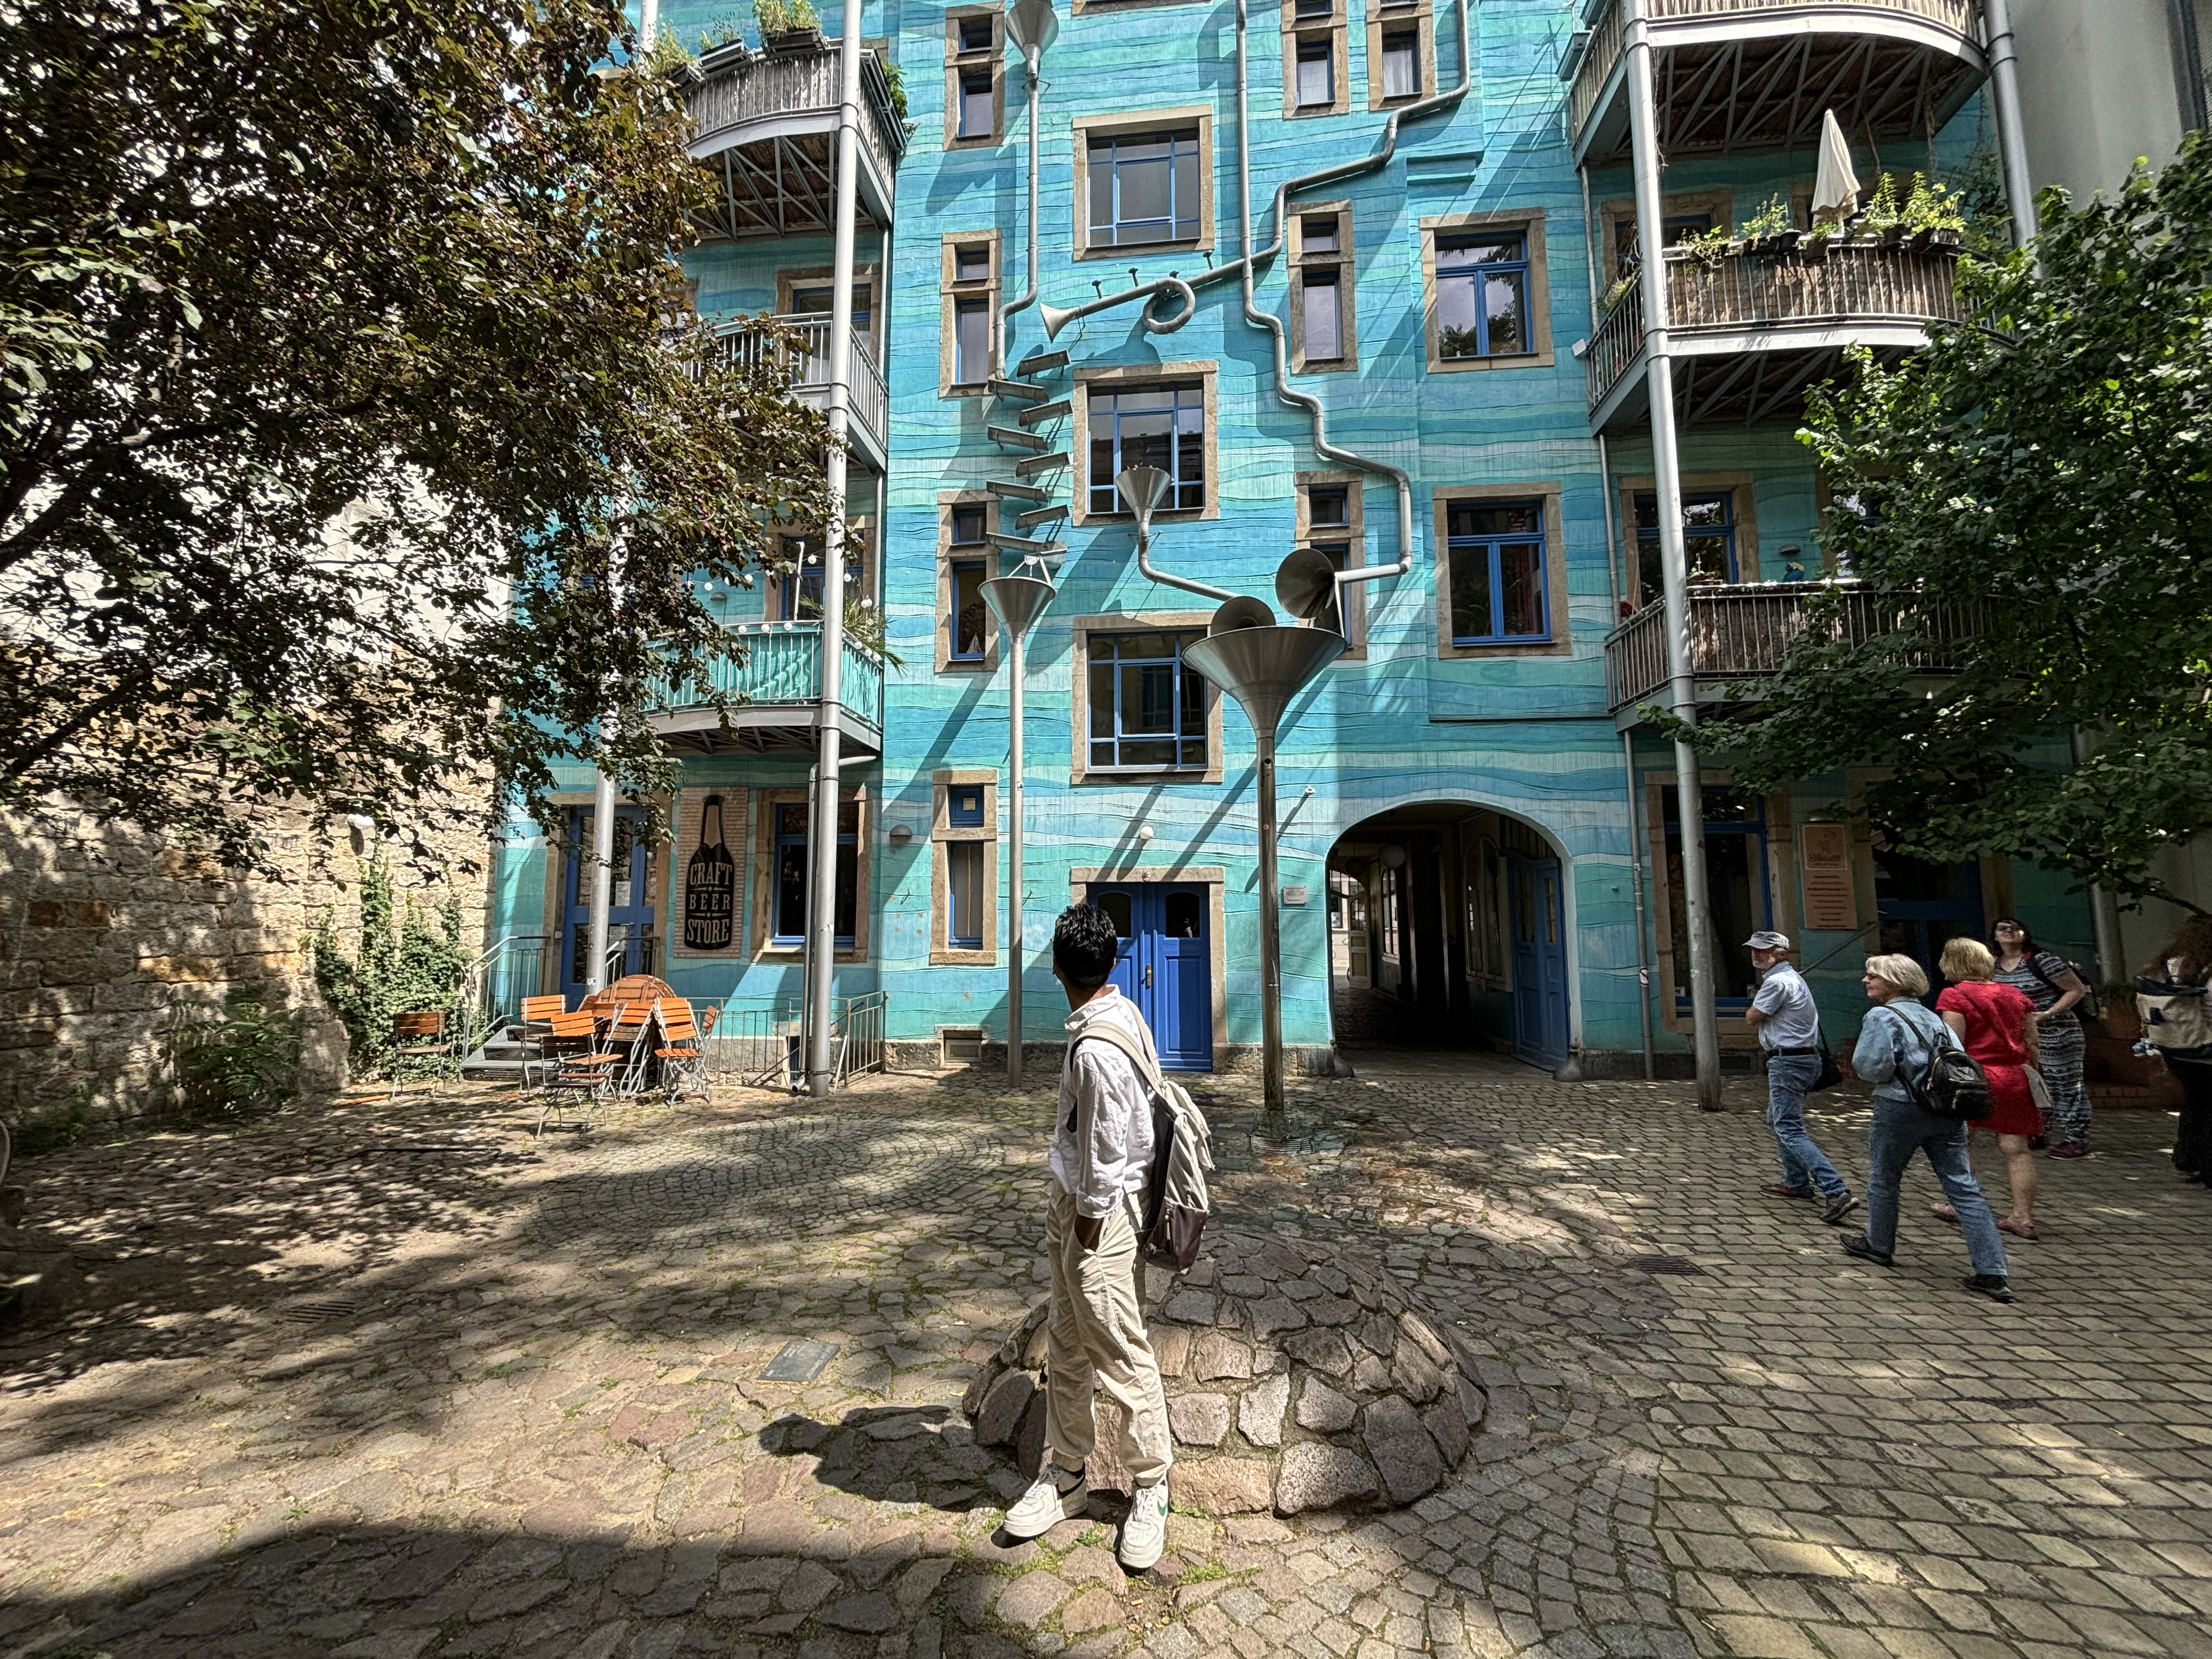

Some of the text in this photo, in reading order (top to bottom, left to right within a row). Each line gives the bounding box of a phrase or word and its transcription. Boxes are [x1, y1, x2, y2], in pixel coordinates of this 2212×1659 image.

[690, 861, 732, 885] CRAFT
[689, 894, 730, 910] BEER
[687, 918, 730, 944] STORE
